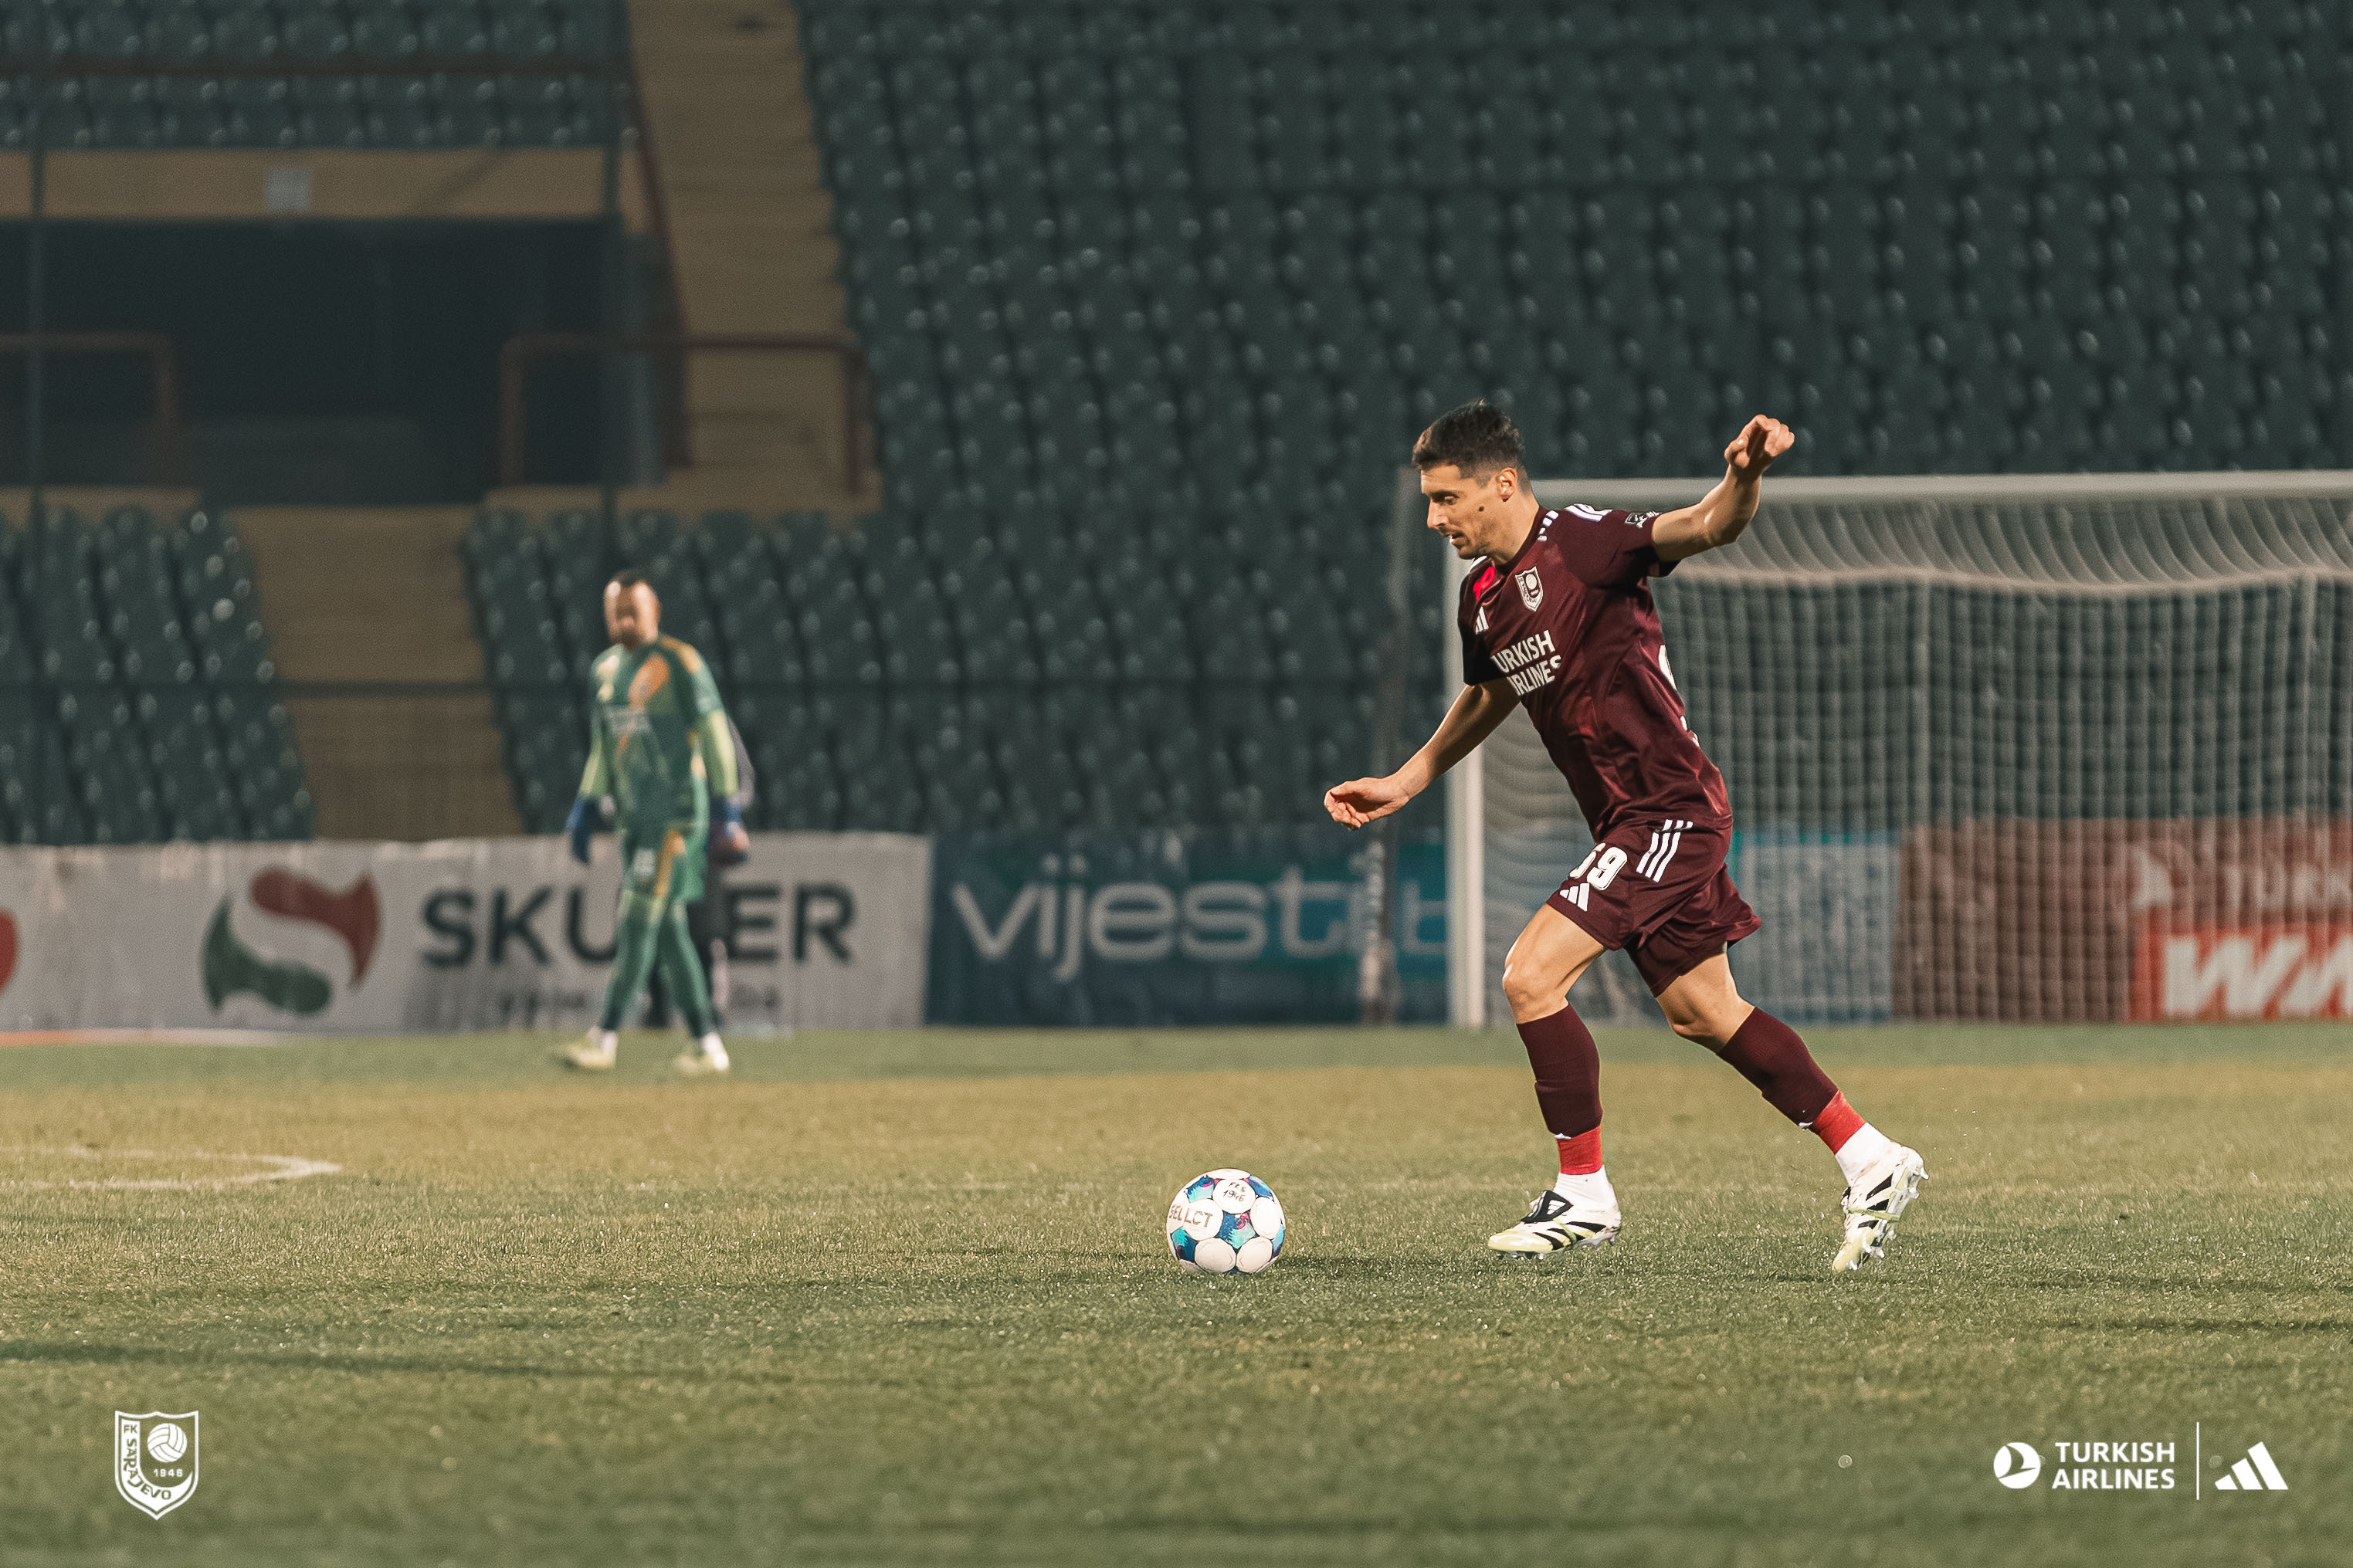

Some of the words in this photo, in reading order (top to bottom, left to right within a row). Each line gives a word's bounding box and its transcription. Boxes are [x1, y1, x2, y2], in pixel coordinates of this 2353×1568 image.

[1488, 629, 1556, 674] URKISH
[1505, 654, 1562, 697] IRLINES
[417, 882, 857, 968] SKUER
